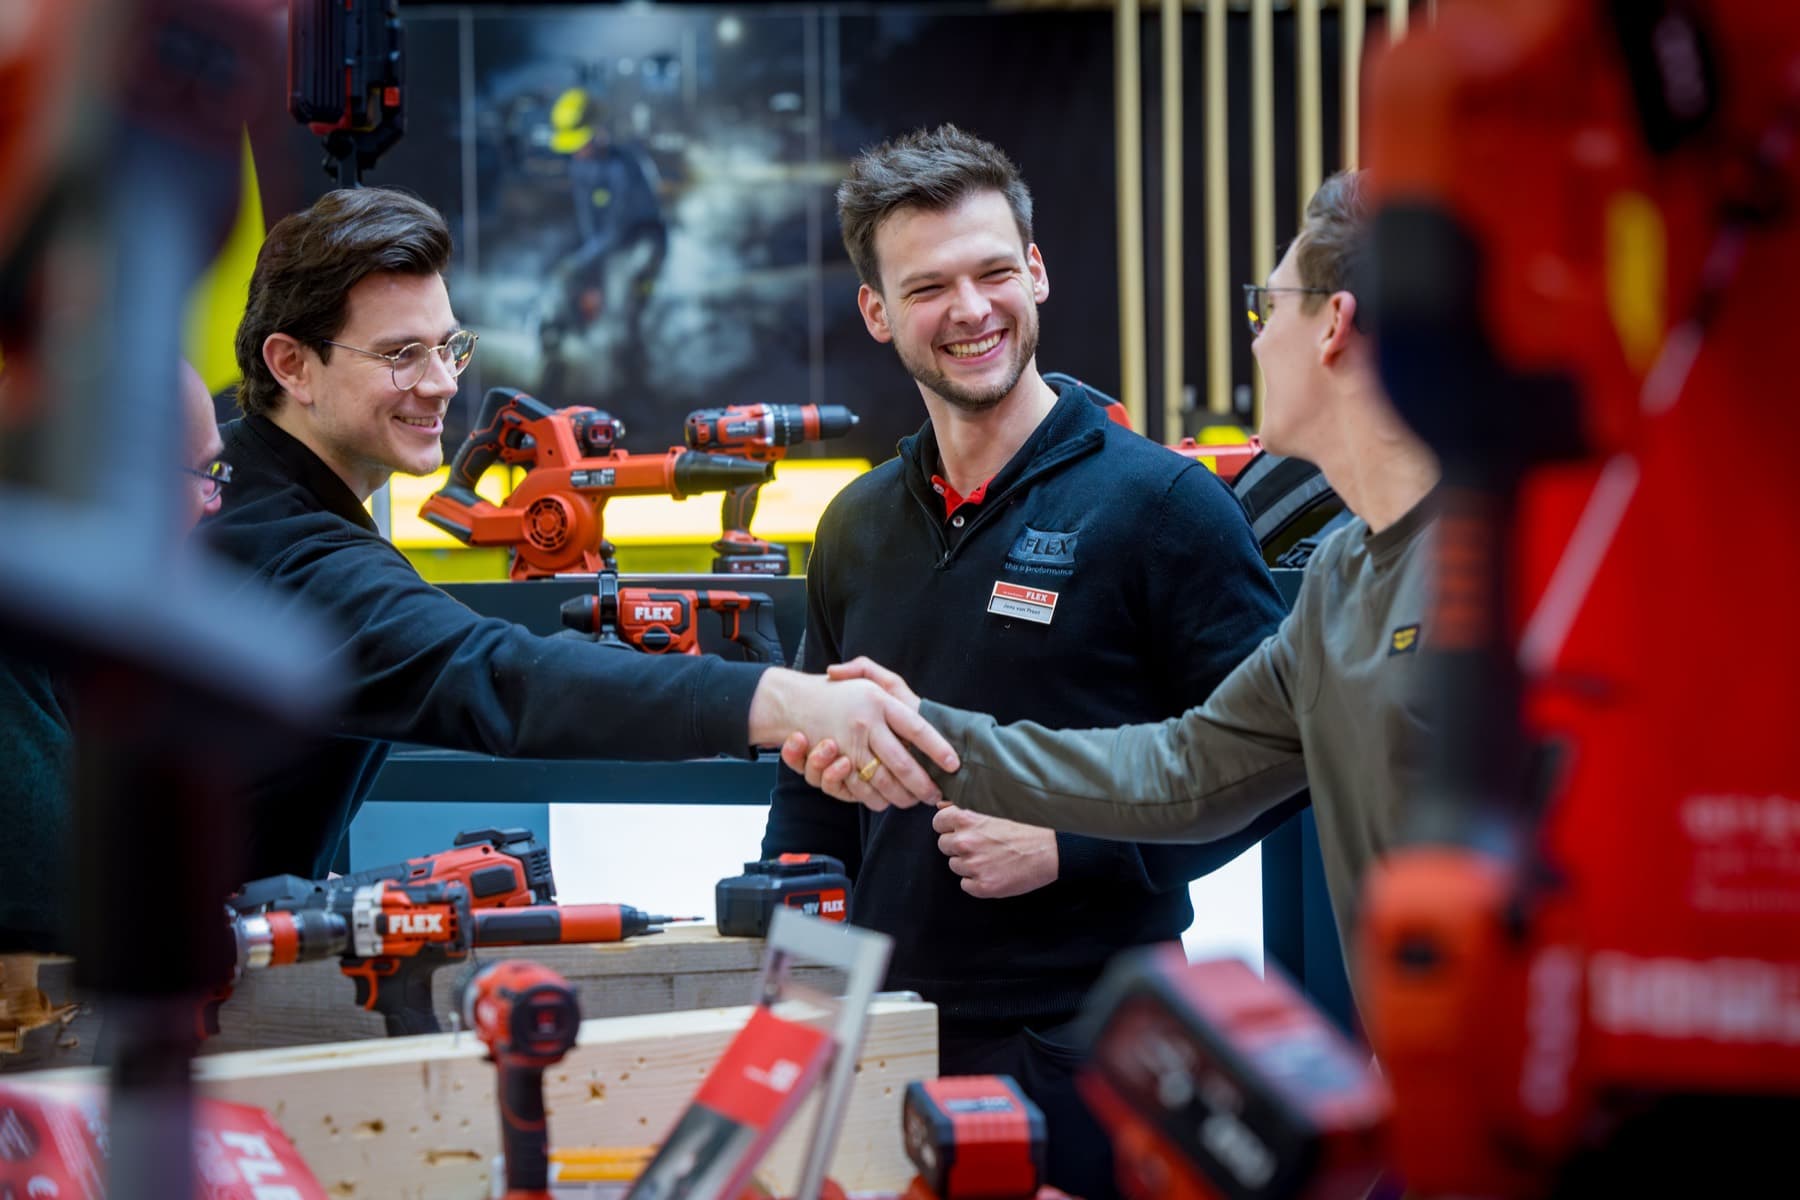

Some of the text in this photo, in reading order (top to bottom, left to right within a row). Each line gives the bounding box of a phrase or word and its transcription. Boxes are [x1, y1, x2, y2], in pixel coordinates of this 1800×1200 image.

[1024, 537, 1072, 556] FLEX
[1026, 591, 1049, 602] FLEX
[634, 606, 674, 621] FLEX
[822, 900, 845, 913] FLEX
[389, 913, 443, 934] FLEX
